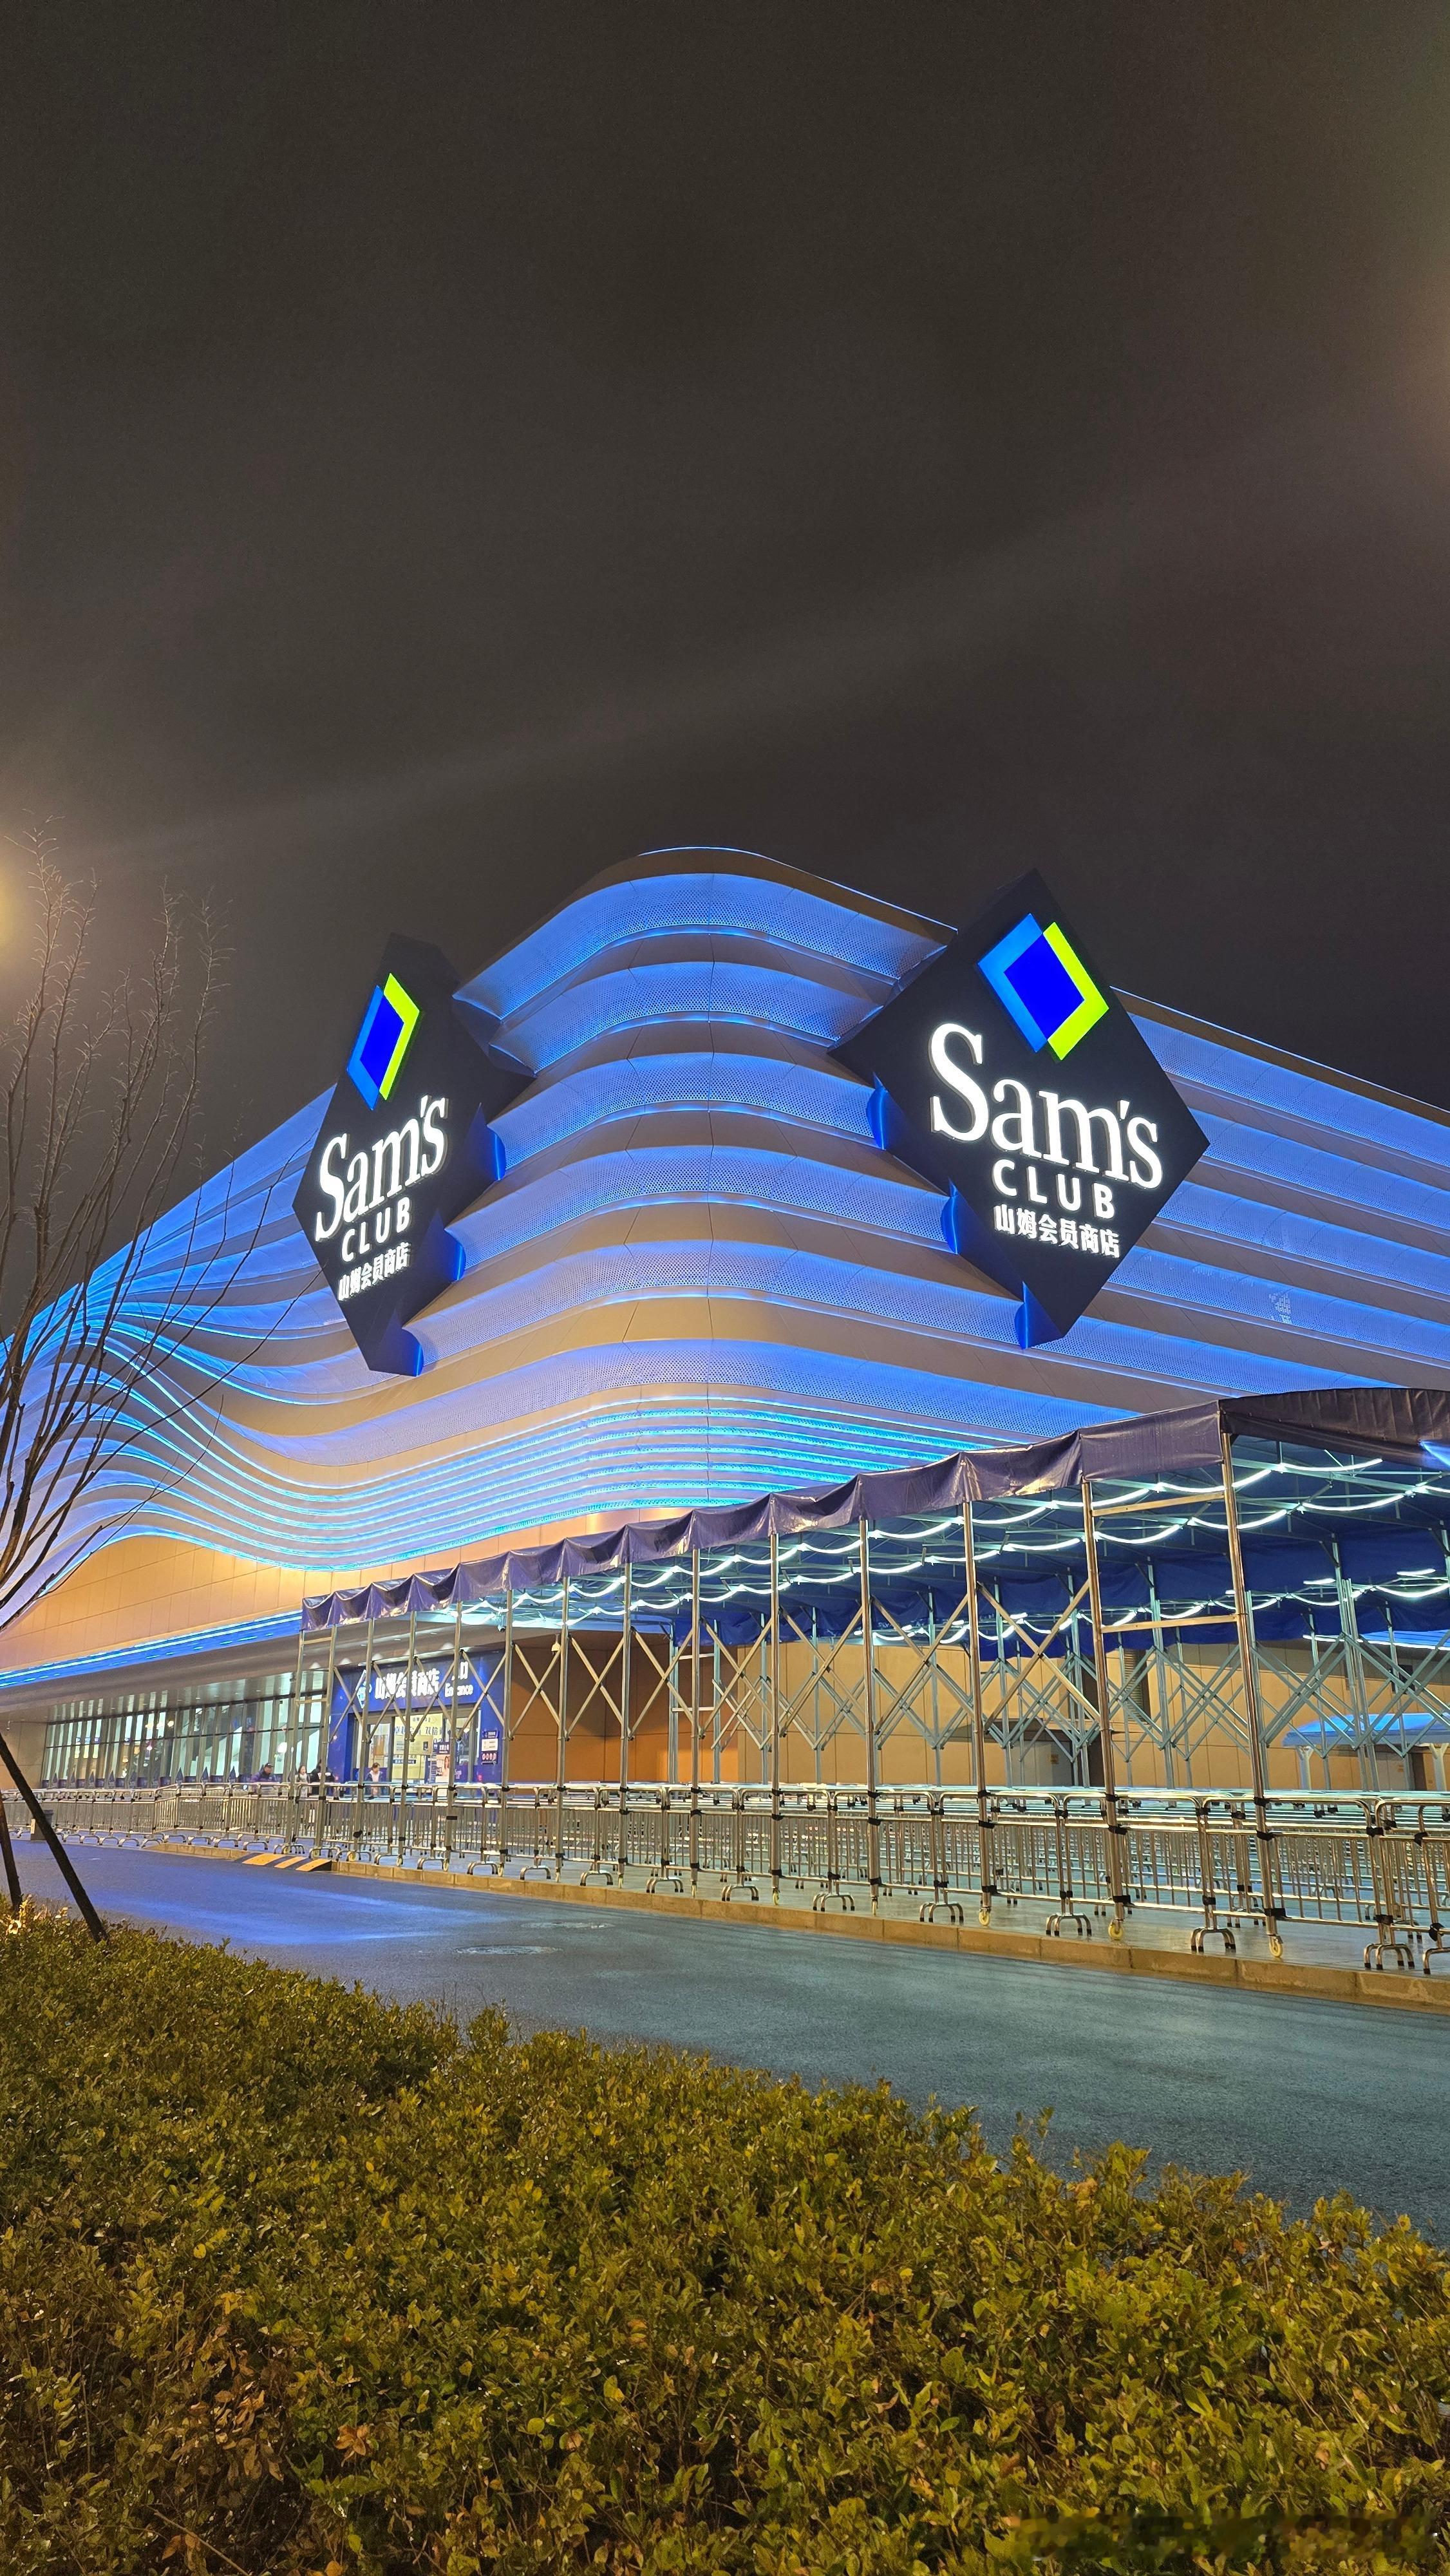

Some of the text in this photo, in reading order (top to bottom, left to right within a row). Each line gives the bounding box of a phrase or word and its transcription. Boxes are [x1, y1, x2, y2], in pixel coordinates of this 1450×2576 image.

[930, 1023, 1163, 1189] Sam's
[314, 1095, 446, 1242] Sam's
[992, 1159, 1116, 1220] CLUB
[341, 1197, 411, 1262] CLUB
[993, 1204, 1120, 1259] 山姆会员商店
[338, 1242, 410, 1302] 山姆会员商店
[444, 1683, 474, 1698] Enance
